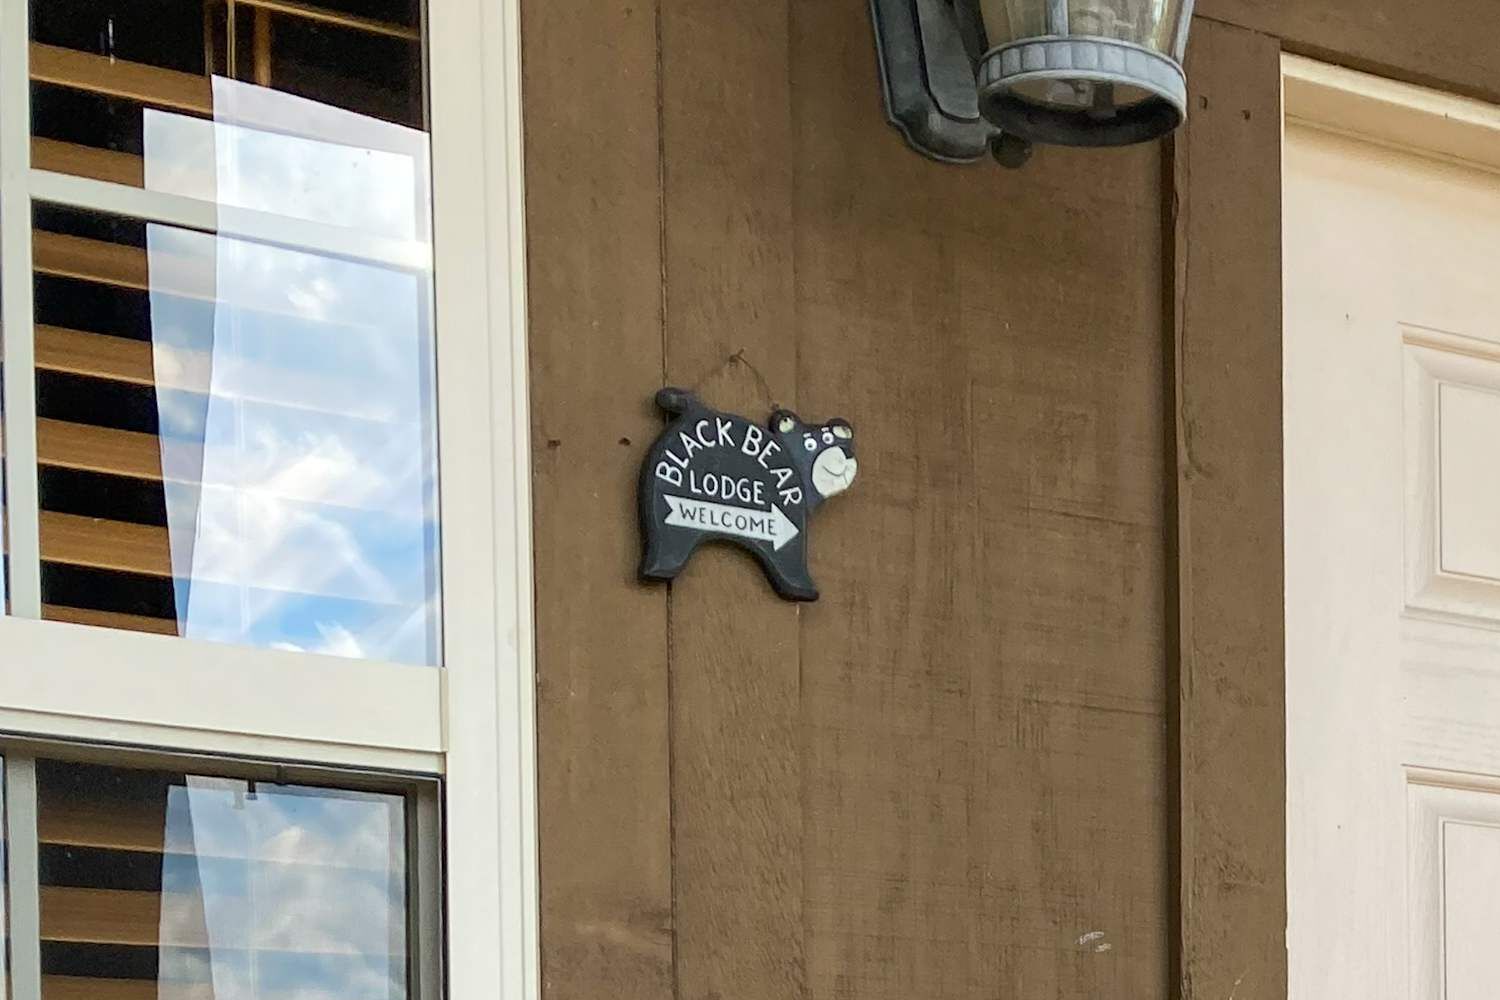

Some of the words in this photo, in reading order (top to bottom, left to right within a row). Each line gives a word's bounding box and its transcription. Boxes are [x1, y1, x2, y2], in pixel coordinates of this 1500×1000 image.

[655, 417, 735, 487] BLACK
[741, 424, 803, 506] BEAR
[689, 470, 765, 505] LODGE
[679, 503, 777, 536] WELCOME
